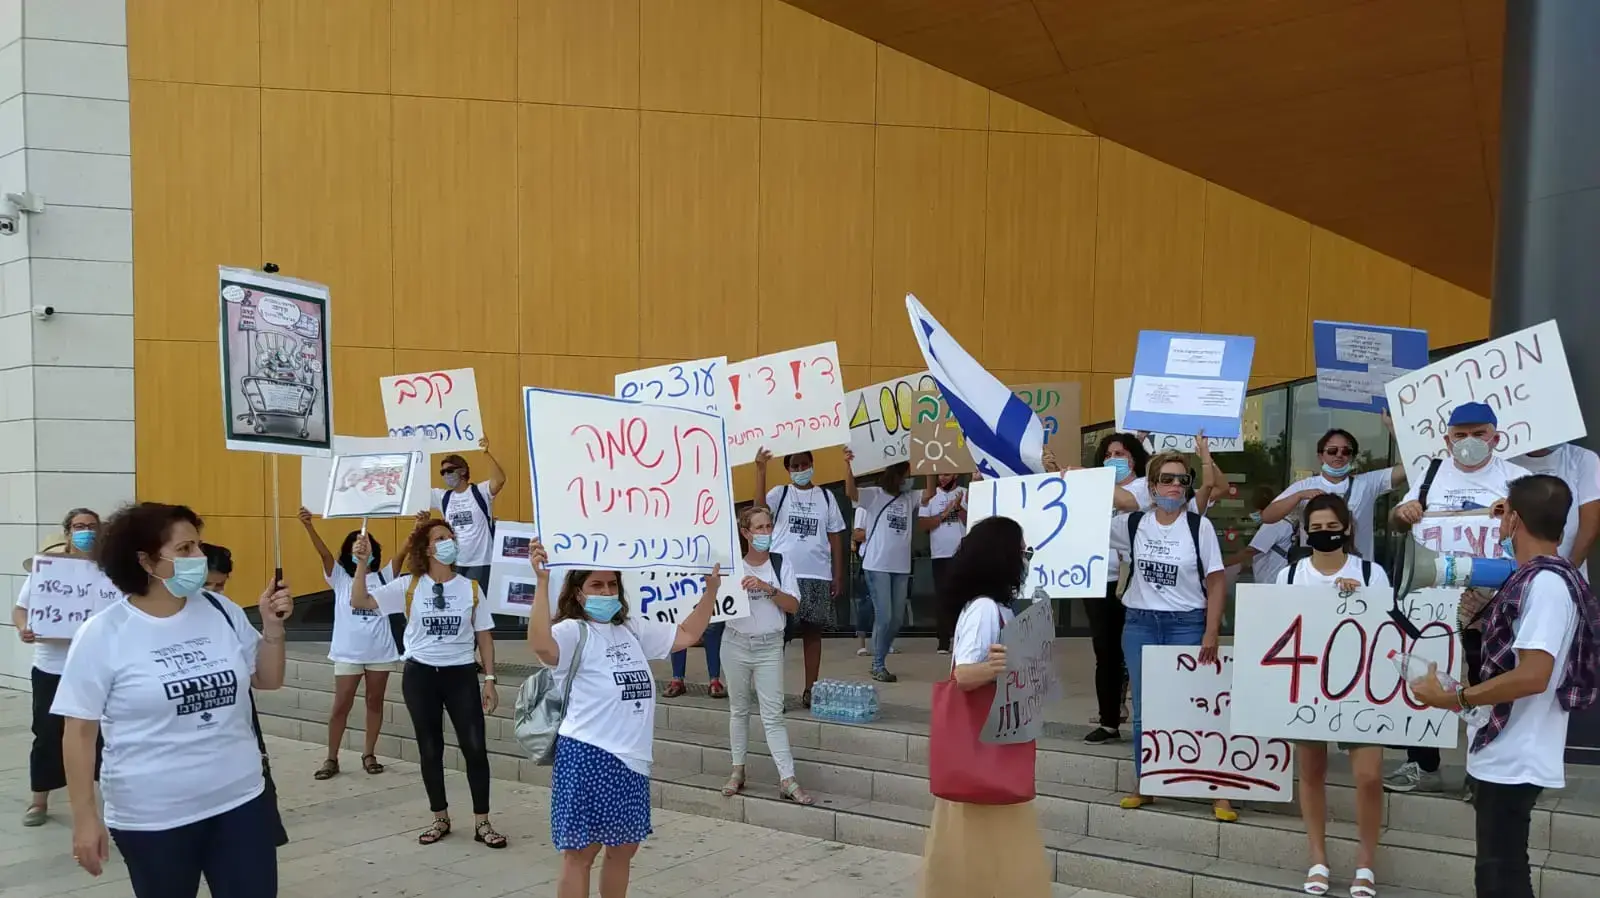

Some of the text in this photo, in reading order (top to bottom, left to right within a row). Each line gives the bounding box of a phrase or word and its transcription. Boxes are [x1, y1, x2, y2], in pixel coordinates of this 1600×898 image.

[620, 362, 716, 400] עוצרים
[1398, 333, 1543, 417] מפקירים
[394, 373, 453, 409] קרב
[453, 408, 475, 441] על
[770, 401, 842, 440] להפקרת
[571, 417, 718, 485] הנשמה
[567, 477, 720, 526] של החינוך
[553, 532, 609, 562] קרב
[629, 534, 711, 563] תוכנית
[1138, 560, 1177, 574] עוצרים
[423, 616, 460, 626] עוצרים
[154, 650, 208, 670] מפקיר
[166, 671, 235, 699] עוצרים
[615, 671, 649, 685] עוצרים
[186, 685, 235, 703] את סגירת
[204, 695, 234, 706] תכנית
[1287, 700, 1449, 742] מובטלים
